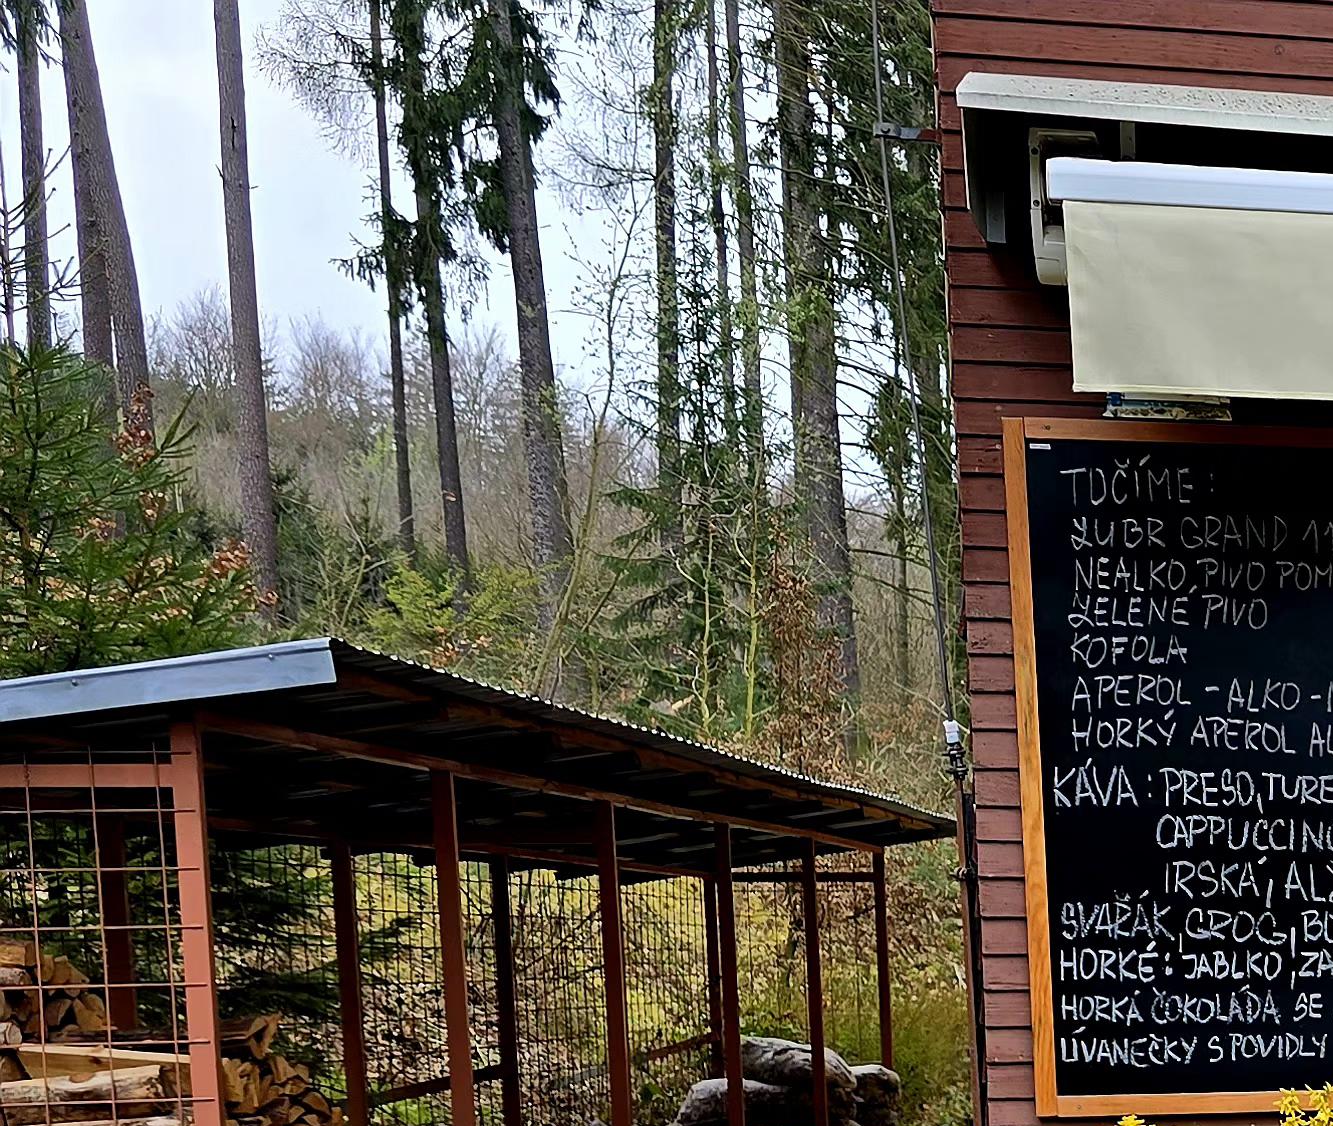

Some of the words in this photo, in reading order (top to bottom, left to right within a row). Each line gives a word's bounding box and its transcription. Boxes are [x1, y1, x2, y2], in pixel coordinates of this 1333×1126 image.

[1071, 517, 1166, 550] ZUBR
[1181, 515, 1287, 552] GRAND
[1076, 557, 1187, 592] NEALKO
[1197, 558, 1265, 591] PIVO
[1068, 585, 1197, 628] ZELENÉ
[1202, 594, 1268, 629] PIVO
[1070, 632, 1187, 668] KOFOLA
[1072, 674, 1191, 712] APEROL
[1072, 709, 1176, 751] HORKÝ
[1191, 715, 1296, 754] APEROL
[1062, 990, 1144, 1026] HORKÁ
[1151, 984, 1281, 1025] ČOKOLÁDA
[1293, 992, 1323, 1022] SE
